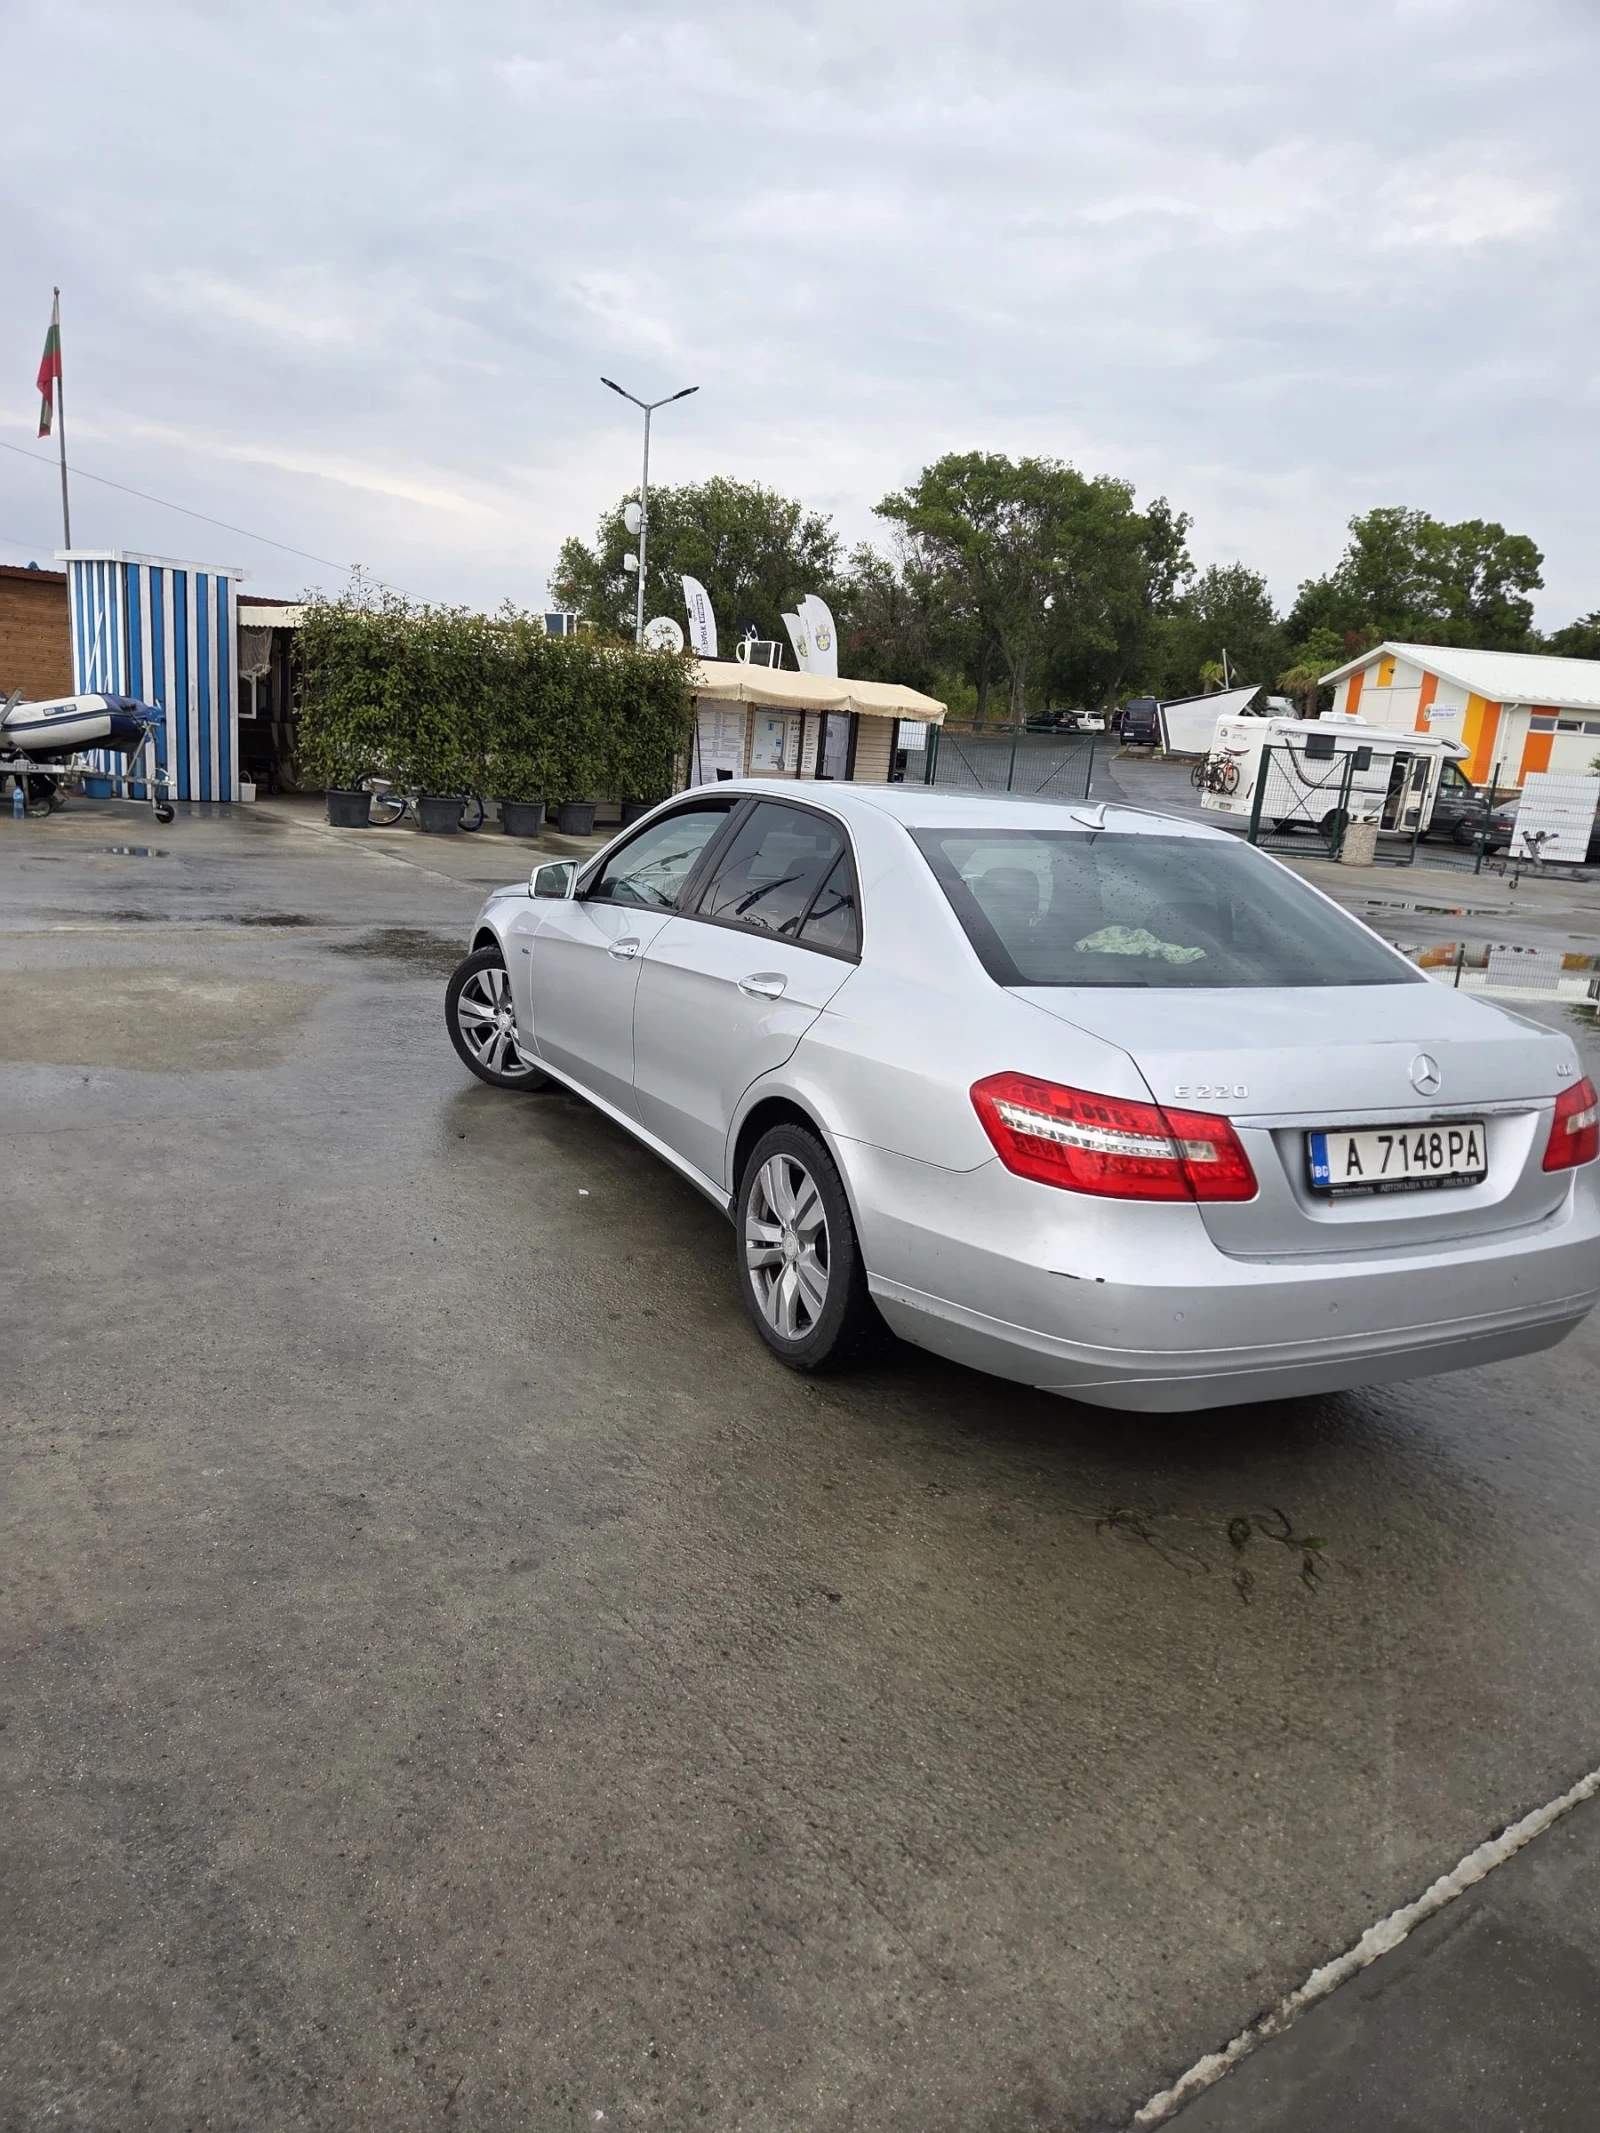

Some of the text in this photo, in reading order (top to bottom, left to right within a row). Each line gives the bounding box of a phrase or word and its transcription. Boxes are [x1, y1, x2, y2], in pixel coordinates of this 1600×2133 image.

[1173, 1084, 1250, 1099] E 220
[1346, 1137, 1364, 1177] A
[1314, 1165, 1329, 1178] BG
